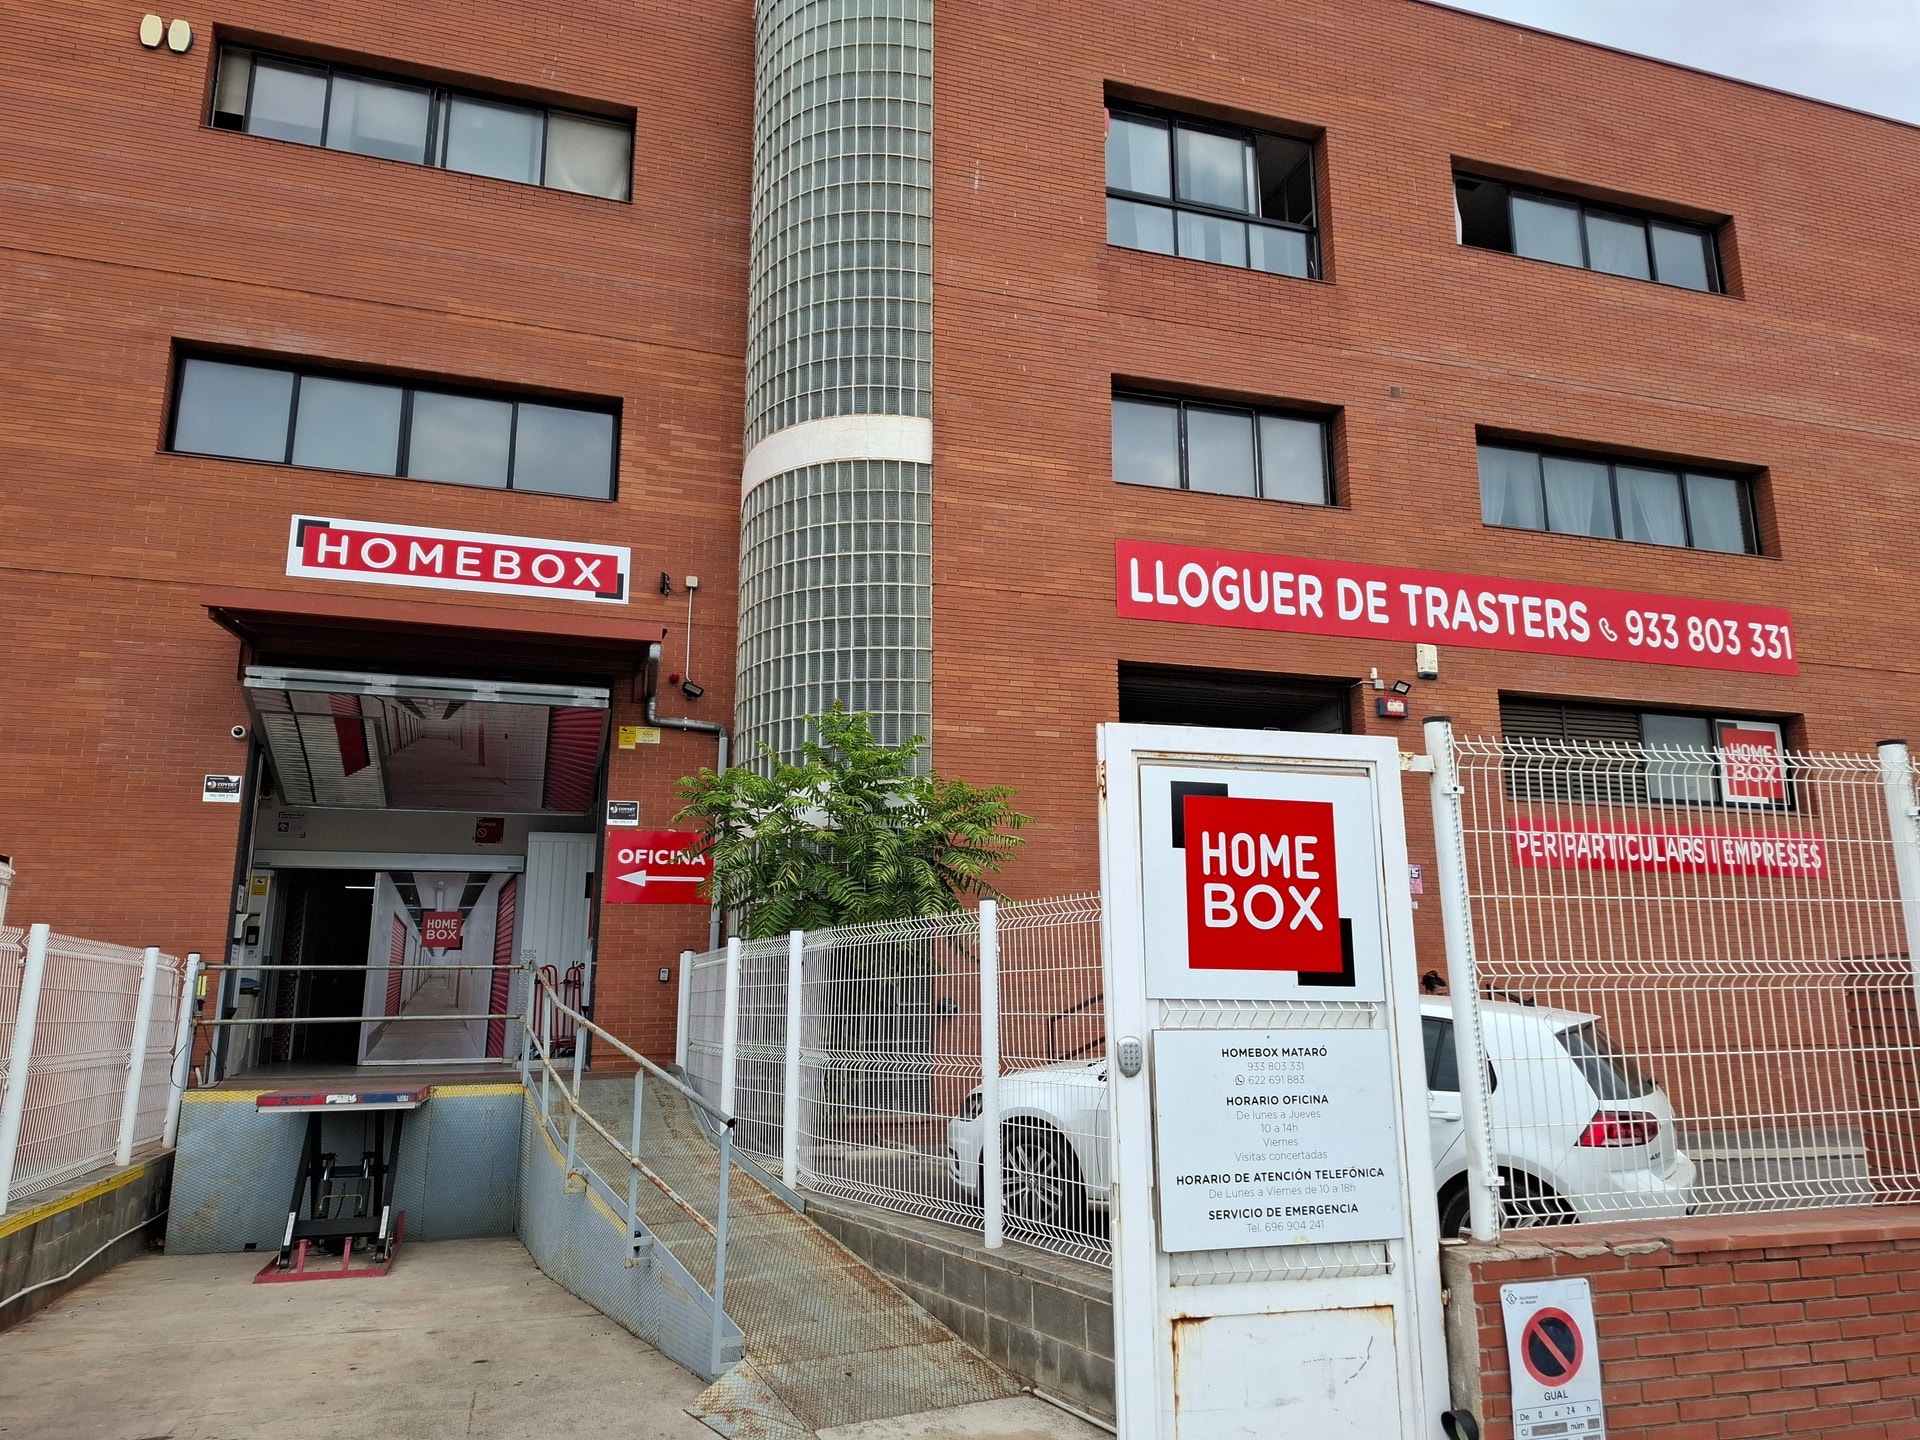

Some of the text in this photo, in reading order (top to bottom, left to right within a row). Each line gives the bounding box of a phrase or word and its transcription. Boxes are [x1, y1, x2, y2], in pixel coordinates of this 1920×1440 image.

[317, 533, 601, 587] HOMEBOX
[1130, 557, 1792, 660] LLOGUER DE TRASTERS 933 803 331
[1730, 743, 1773, 763] HOME
[1734, 765, 1777, 783] BOX
[618, 848, 706, 865] OFICINA
[1202, 831, 1320, 879] HOME
[1517, 831, 1557, 858] PER
[1565, 834, 1705, 863] PARTICULARS
[1722, 839, 1822, 869] EMPRESES
[1204, 883, 1323, 931] BOX
[427, 919, 457, 929] HOME
[426, 930, 457, 940] BOX
[1221, 1045, 1327, 1058] HOMEBOX MATARÓ
[1247, 1061, 1305, 1071] 933 803 331
[1248, 1074, 1305, 1085] 622 691 883
[1226, 1094, 1329, 1106] HORARIO OFICINA
[1236, 1111, 1250, 1120] De
[1252, 1110, 1276, 1120] lunes
[1289, 1109, 1320, 1119] Jueves
[1261, 1124, 1271, 1133] 10
[1282, 1123, 1298, 1132] 14h
[1263, 1137, 1298, 1147] Viernes
[1234, 1150, 1327, 1162] Visitas concertadas
[1176, 1166, 1384, 1185] HORARIO DE ATENCIÓN TELEFÓNICA
[1209, 1189, 1223, 1199] De
[1226, 1188, 1254, 1198] Lunes
[1266, 1186, 1302, 1197] Viernes
[1305, 1185, 1317, 1195] de
[1320, 1185, 1330, 1194] 10
[1341, 1183, 1356, 1193] 18h
[1208, 1203, 1359, 1220] SERVICIO DE EMERGENCIA
[1247, 1220, 1324, 1233] Tel. 696 904 241
[1544, 1389, 1568, 1401] GUAL
[1520, 1413, 1529, 1421] De
[1567, 1406, 1575, 1415] 24
[1570, 1421, 1585, 1430] núm
